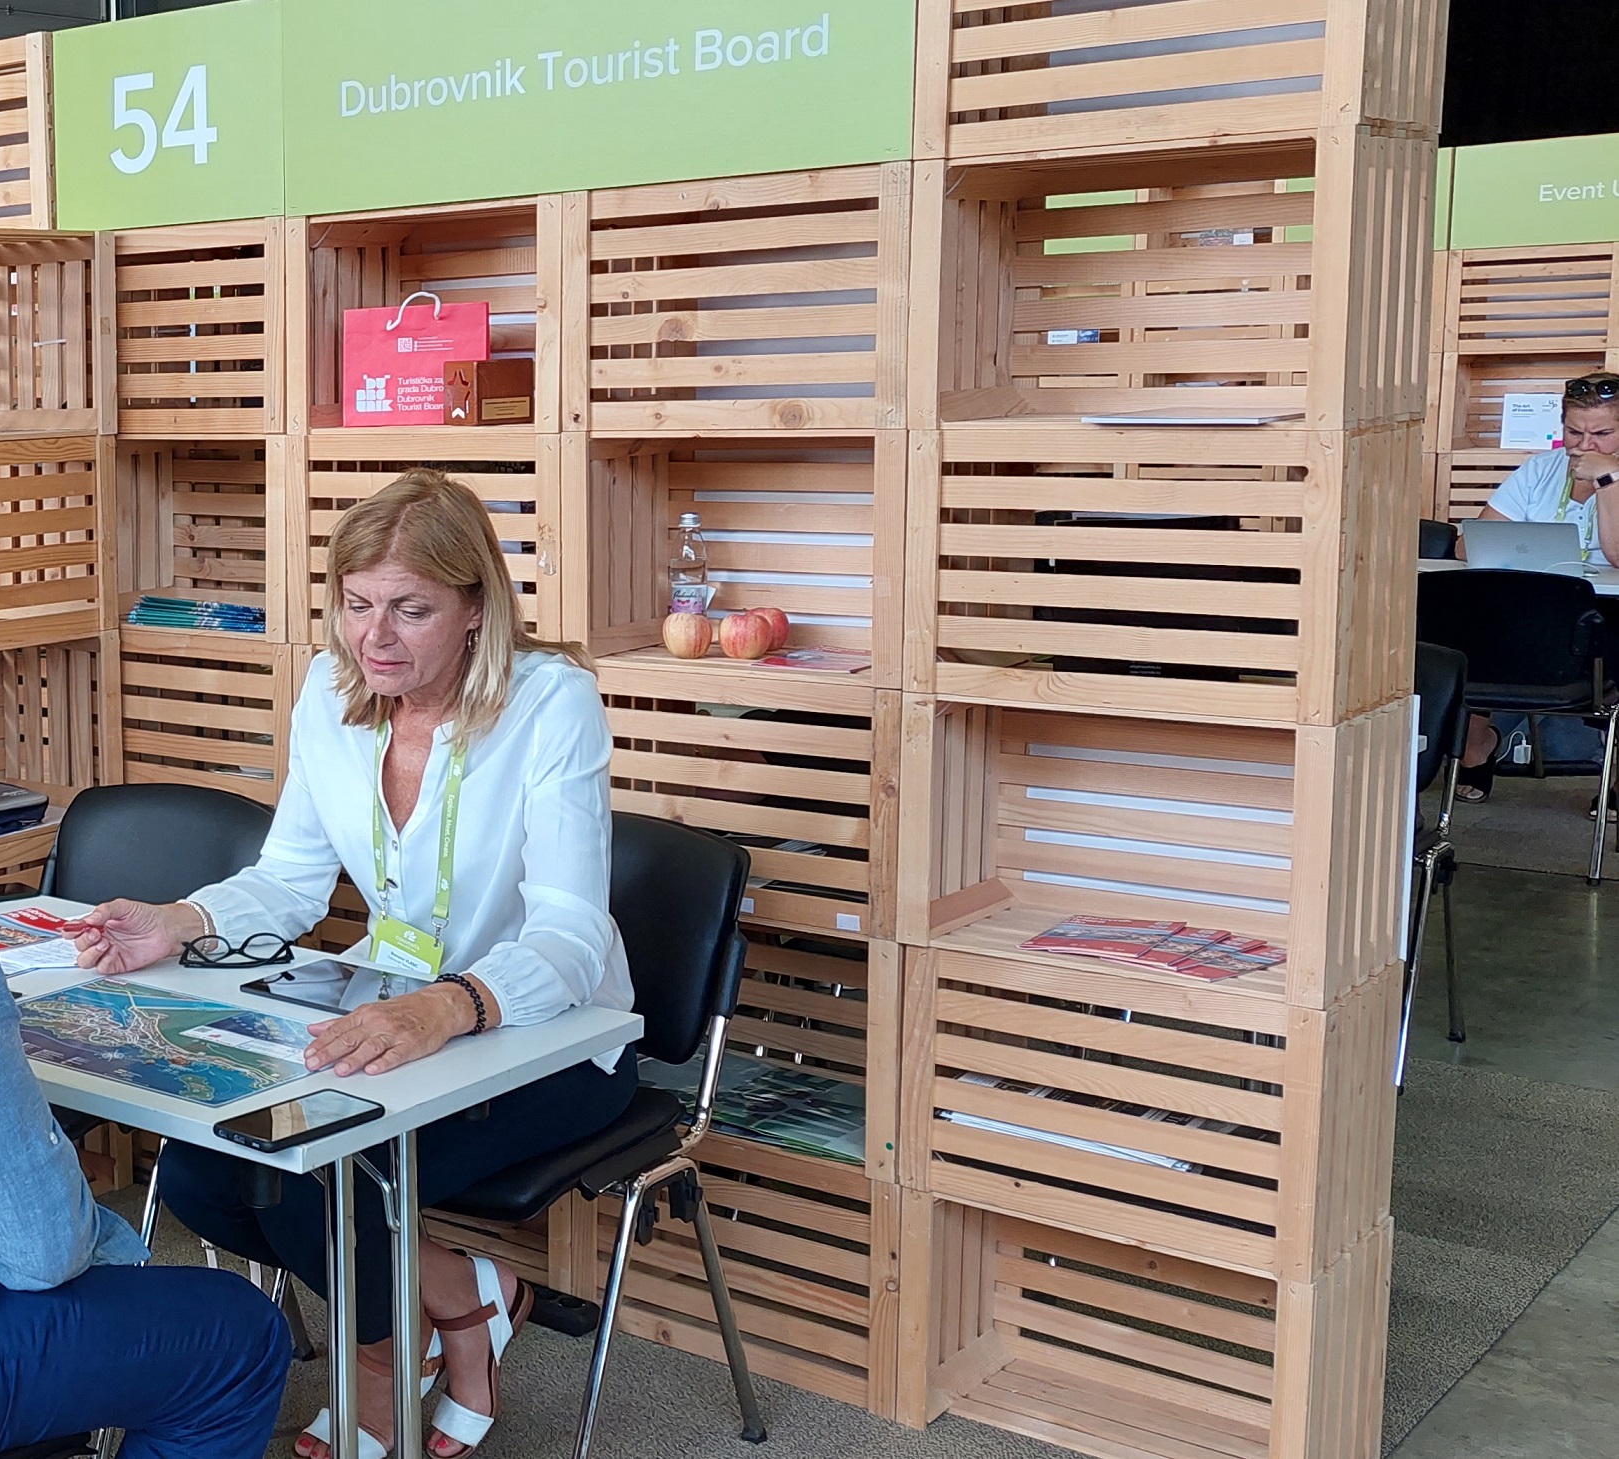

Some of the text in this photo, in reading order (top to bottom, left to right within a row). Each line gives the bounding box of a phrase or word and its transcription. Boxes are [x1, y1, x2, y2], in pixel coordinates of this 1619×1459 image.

[340, 12, 831, 118] Dubrovnik Tourist Board
[108, 64, 219, 175] 54
[1539, 181, 1605, 202] Event
[397, 386, 419, 395] grada
[397, 394, 435, 403] Dubrovnik
[397, 403, 422, 411] Tourist
